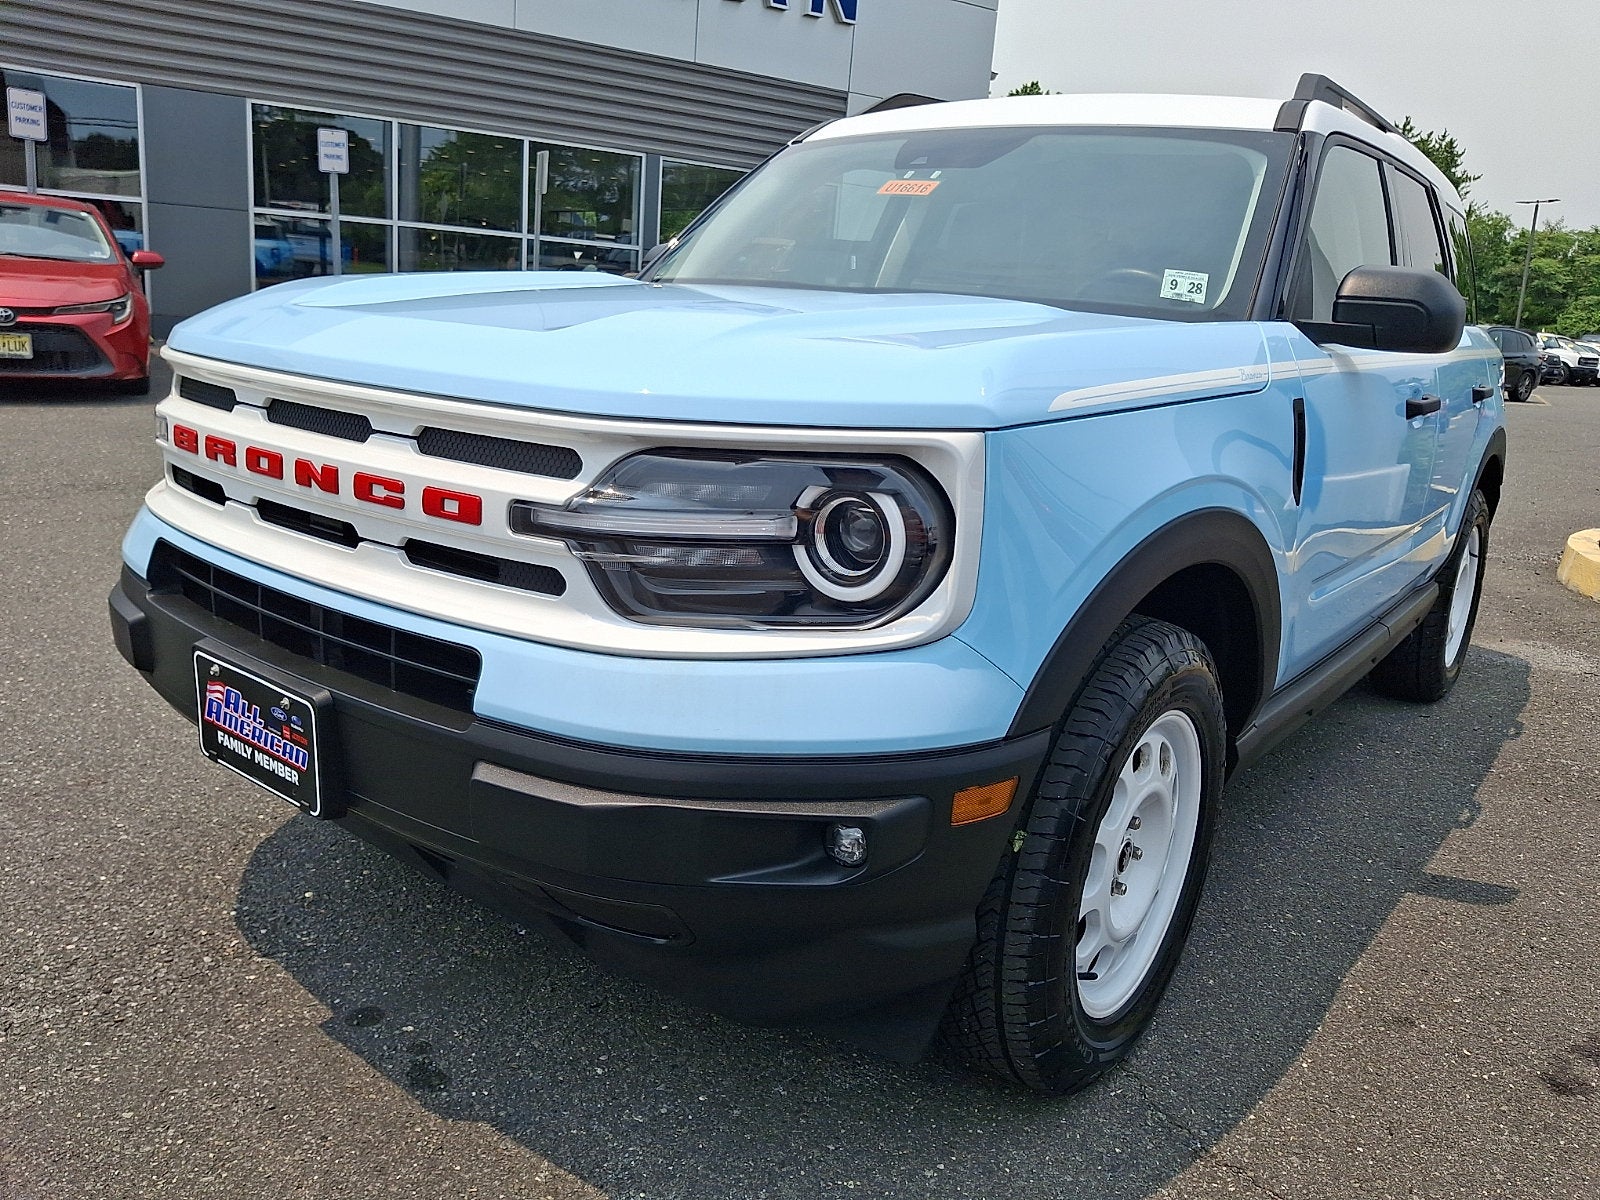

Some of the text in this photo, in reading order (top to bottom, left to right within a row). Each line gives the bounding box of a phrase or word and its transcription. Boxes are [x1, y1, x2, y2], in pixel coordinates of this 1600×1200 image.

[11, 101, 43, 112] CUSTOMER
[15, 116, 40, 126] PARKING
[885, 183, 931, 193] U16616
[1170, 279, 1203, 294] 9 28
[173, 424, 482, 526] BRONCO
[224, 686, 264, 728] ALL
[205, 697, 308, 771] AMERICAN
[217, 730, 253, 760] FAMILY
[254, 752, 300, 786] MEMBER
